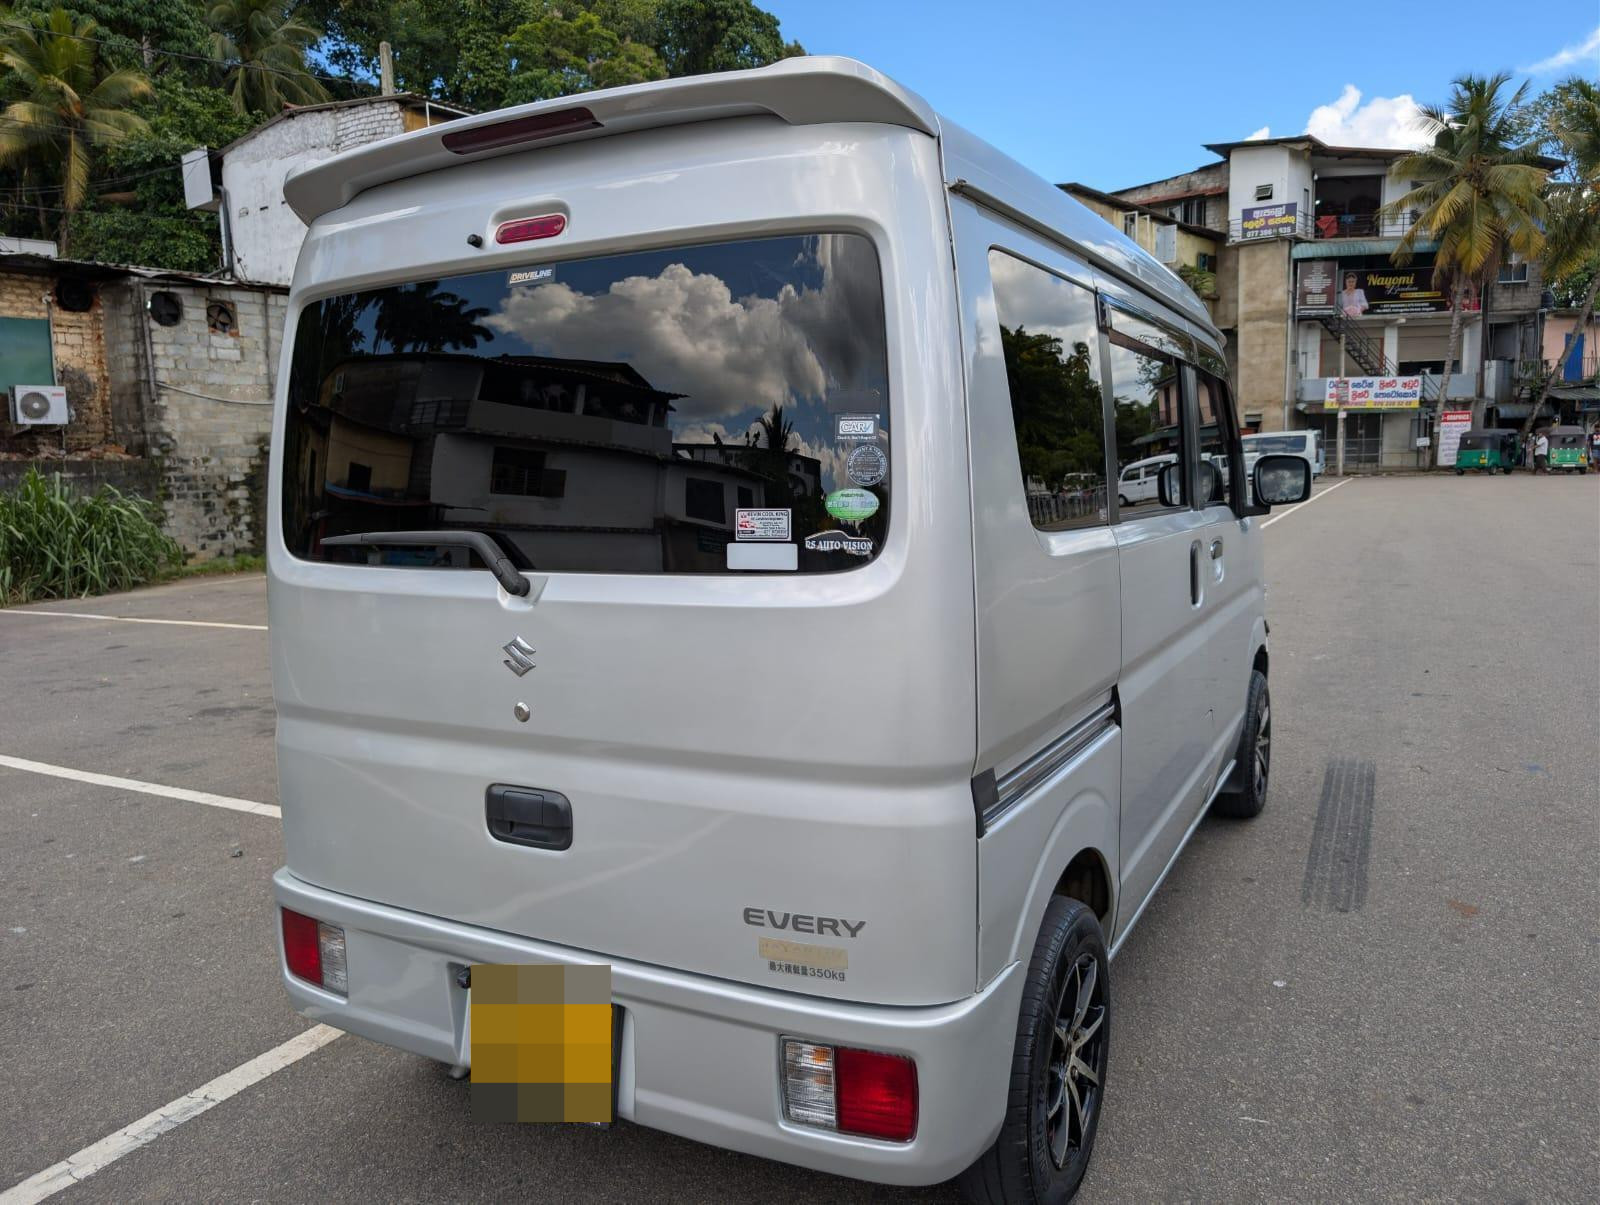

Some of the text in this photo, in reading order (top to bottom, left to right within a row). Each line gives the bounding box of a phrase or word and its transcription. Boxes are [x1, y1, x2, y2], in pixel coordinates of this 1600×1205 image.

[511, 269, 552, 282] DRIVELINE
[1367, 274, 1415, 288] Nayomi
[805, 540, 873, 550] RS AUTO VISION
[743, 907, 866, 938] EVERY
